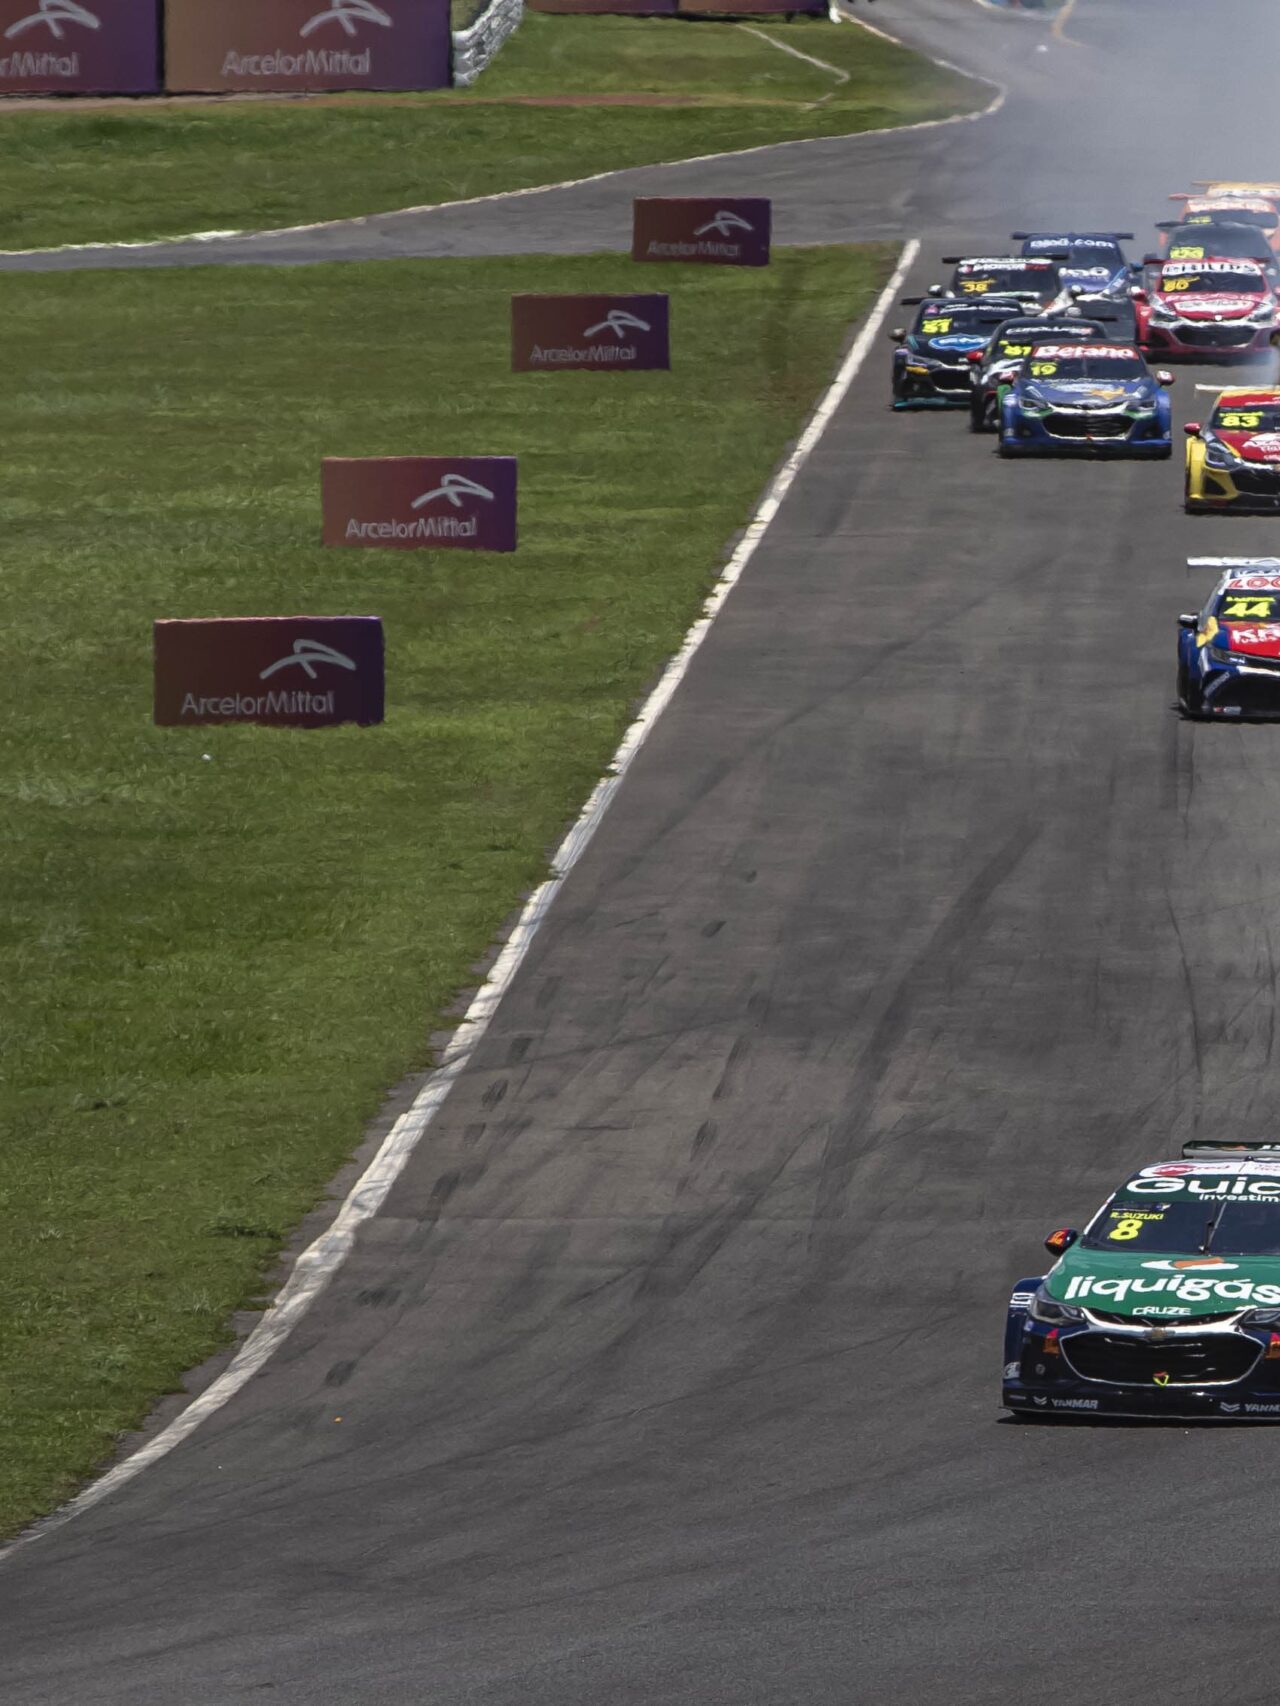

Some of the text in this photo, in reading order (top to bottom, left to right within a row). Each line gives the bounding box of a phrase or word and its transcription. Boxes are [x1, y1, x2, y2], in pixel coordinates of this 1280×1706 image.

[221, 49, 371, 76] ArcelorMittal
[647, 240, 740, 257] ArcelorMittal
[531, 343, 636, 361] ArcelorMittal
[1034, 345, 1135, 360] Betano
[1221, 415, 1260, 428] 83
[345, 514, 477, 539] ArcelorMittal
[1223, 601, 1271, 617] 44
[181, 690, 335, 716] ArcelorMittal
[1110, 1211, 1164, 1220] R.SUZUKI
[1109, 1219, 1143, 1241] 8
[1132, 1305, 1193, 1316] CRUZE
